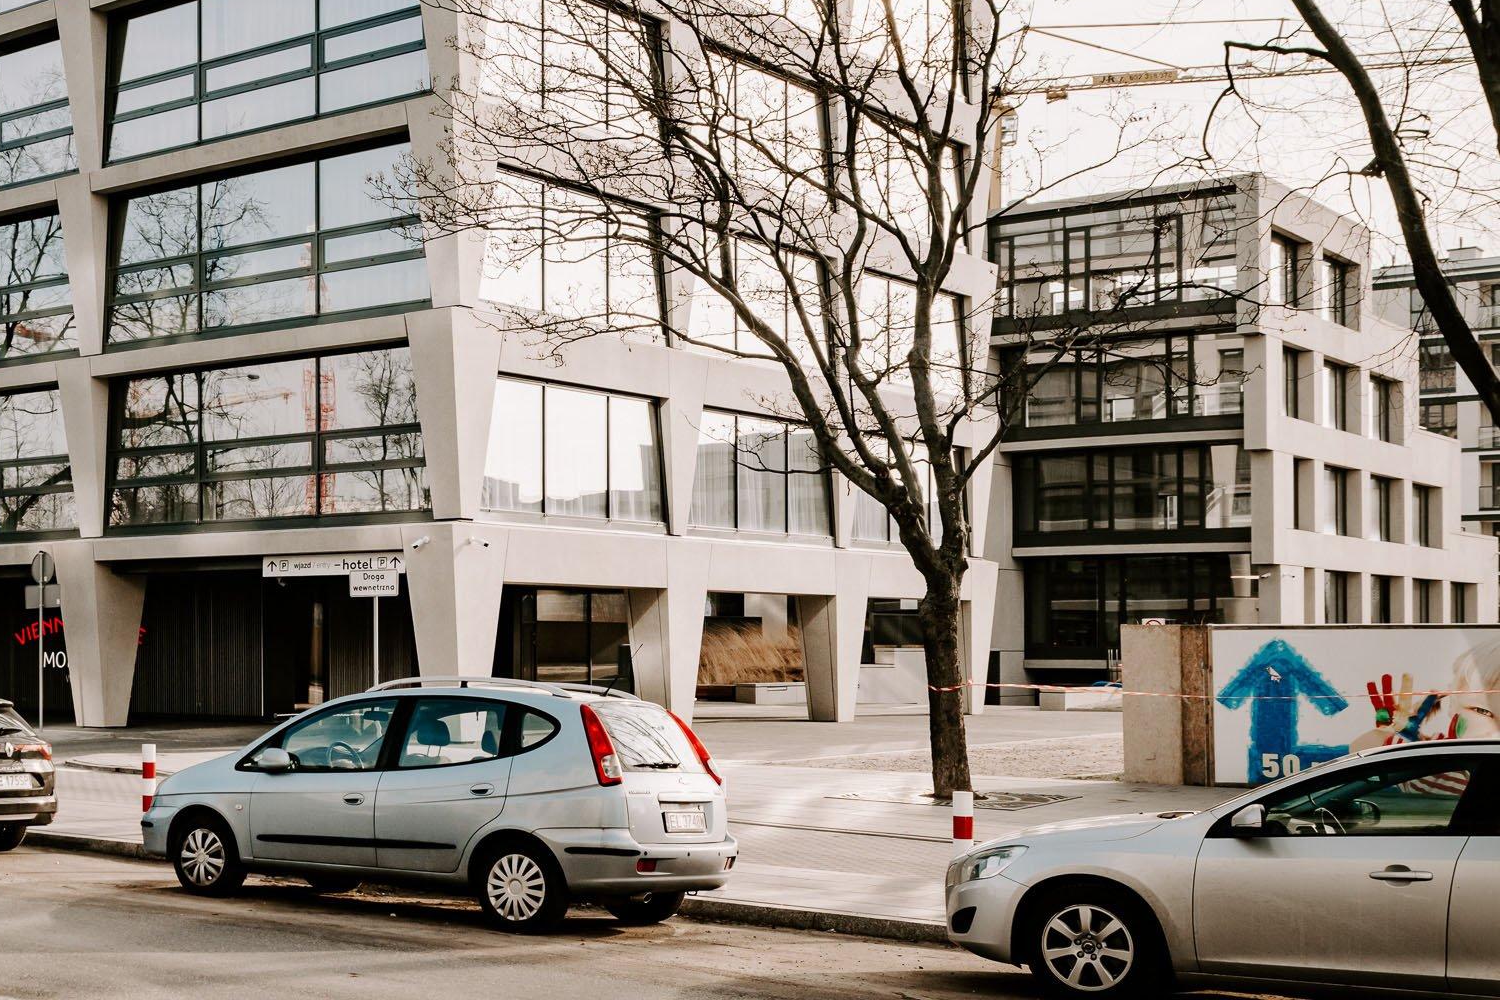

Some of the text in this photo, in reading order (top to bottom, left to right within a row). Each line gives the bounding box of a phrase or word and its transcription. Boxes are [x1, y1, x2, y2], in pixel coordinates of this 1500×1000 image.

[294, 561, 311, 571] wjazd
[363, 572, 385, 582] Droga
[14, 616, 66, 646] VIENN
[1262, 753, 1300, 778] 50
[669, 814, 683, 829] EL
